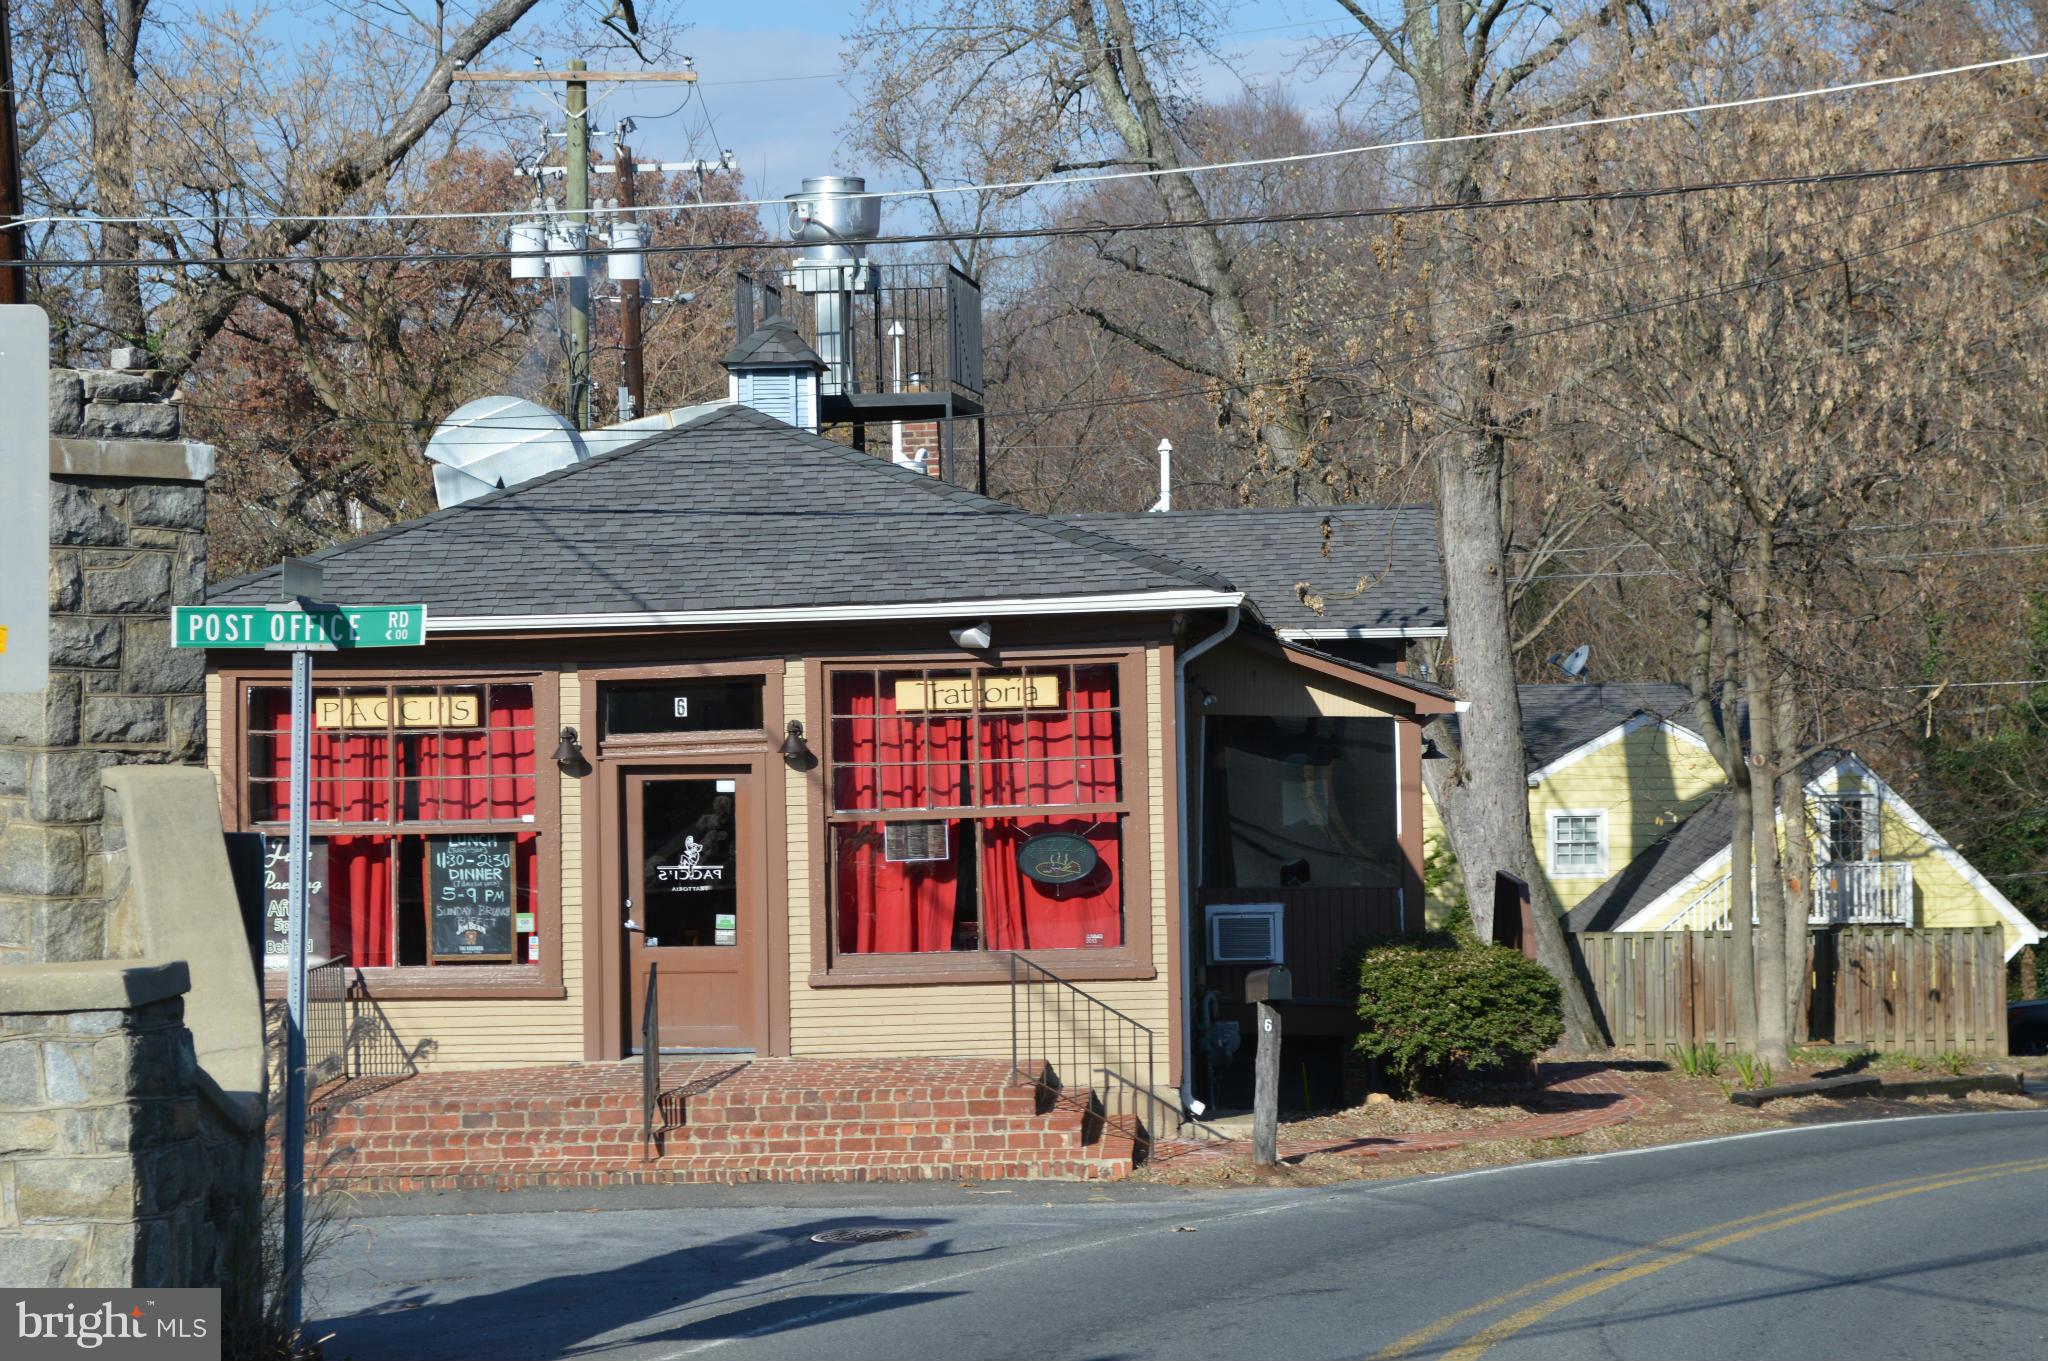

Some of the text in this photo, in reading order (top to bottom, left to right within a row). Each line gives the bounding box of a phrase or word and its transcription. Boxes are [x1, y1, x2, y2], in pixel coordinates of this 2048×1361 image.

[189, 614, 361, 641] POST OFFICE
[388, 611, 409, 629] RD
[675, 698, 687, 717] 6
[448, 834, 498, 847] LUNCH
[264, 838, 313, 868] Fre
[264, 870, 323, 894] Parng
[449, 867, 503, 881] DINNER
[441, 886, 505, 904] 5-9 PM
[267, 899, 311, 917] Aft
[435, 904, 472, 917] SUNDAY
[265, 938, 314, 955] Behd
[1264, 1019, 1273, 1031] 6
